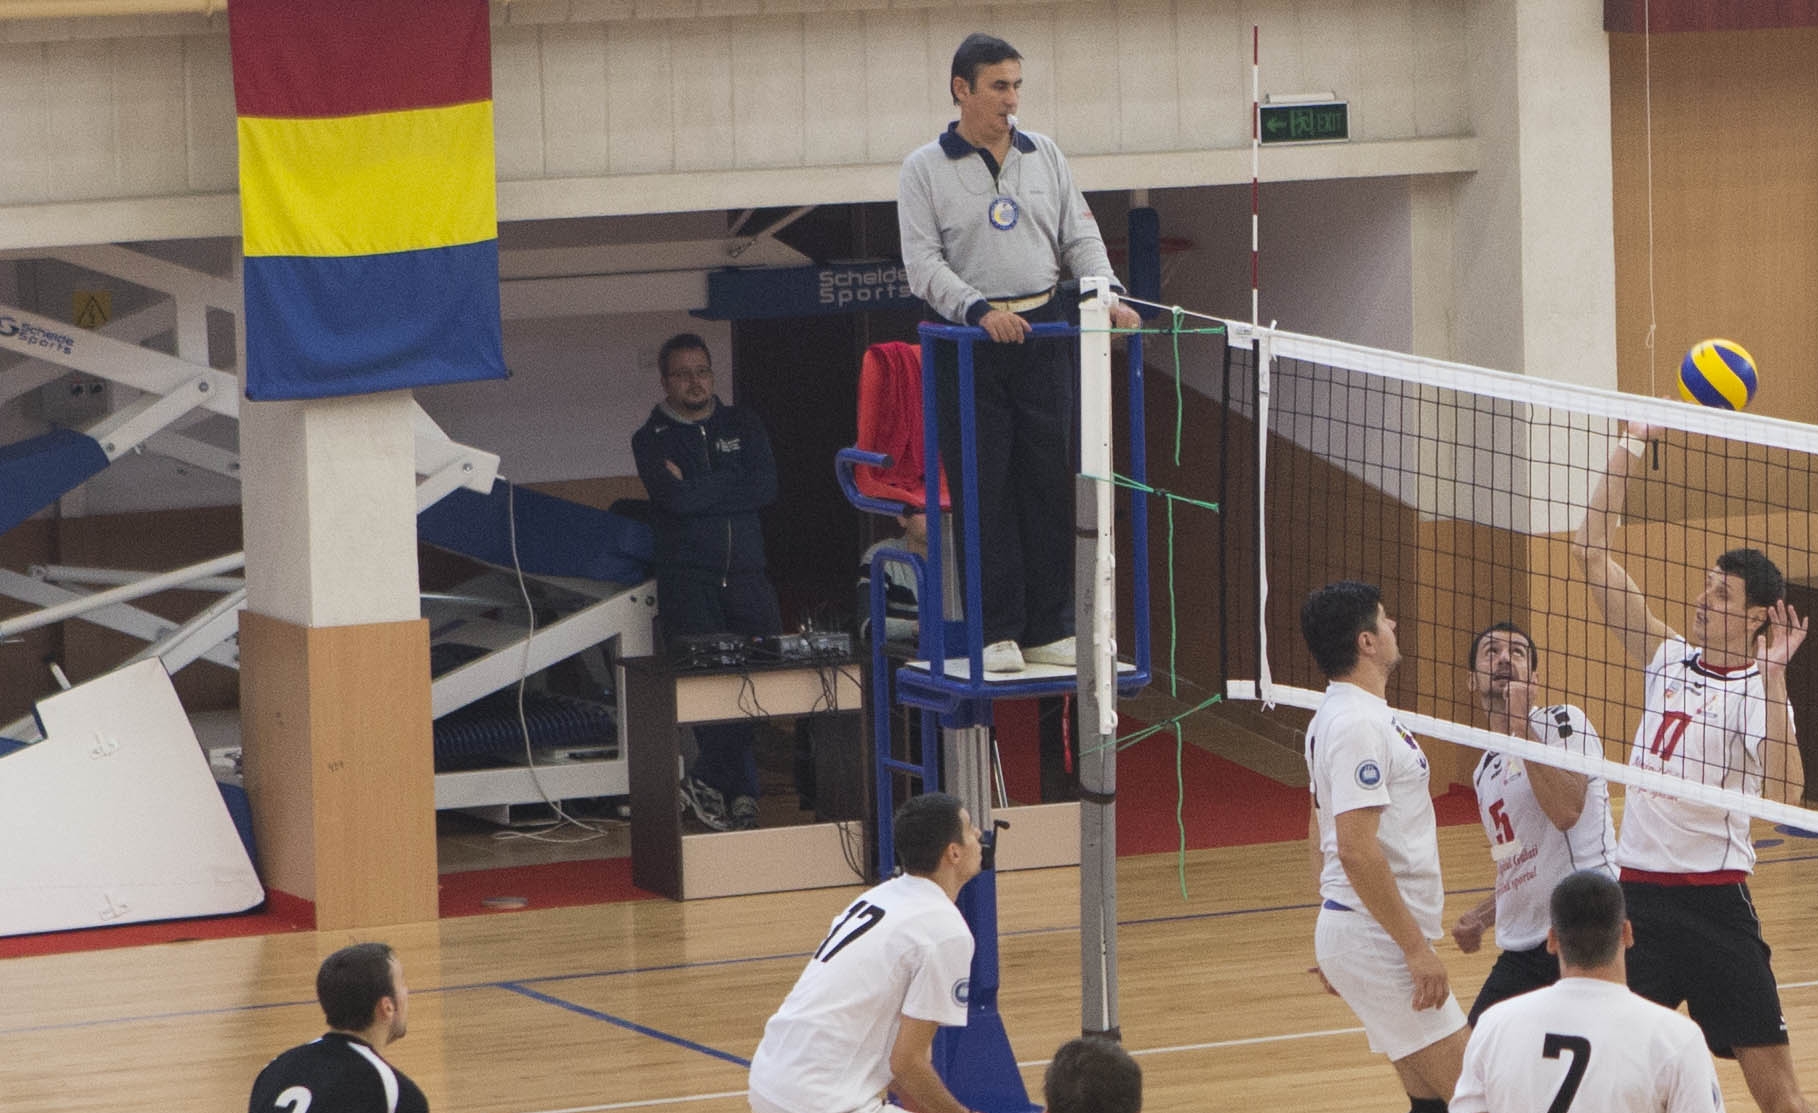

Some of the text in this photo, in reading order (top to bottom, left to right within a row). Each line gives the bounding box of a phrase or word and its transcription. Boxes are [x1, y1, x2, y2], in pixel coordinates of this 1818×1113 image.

[820, 284, 913, 307] Sports
[1488, 798, 1515, 845] 5
[814, 900, 886, 963] 17
